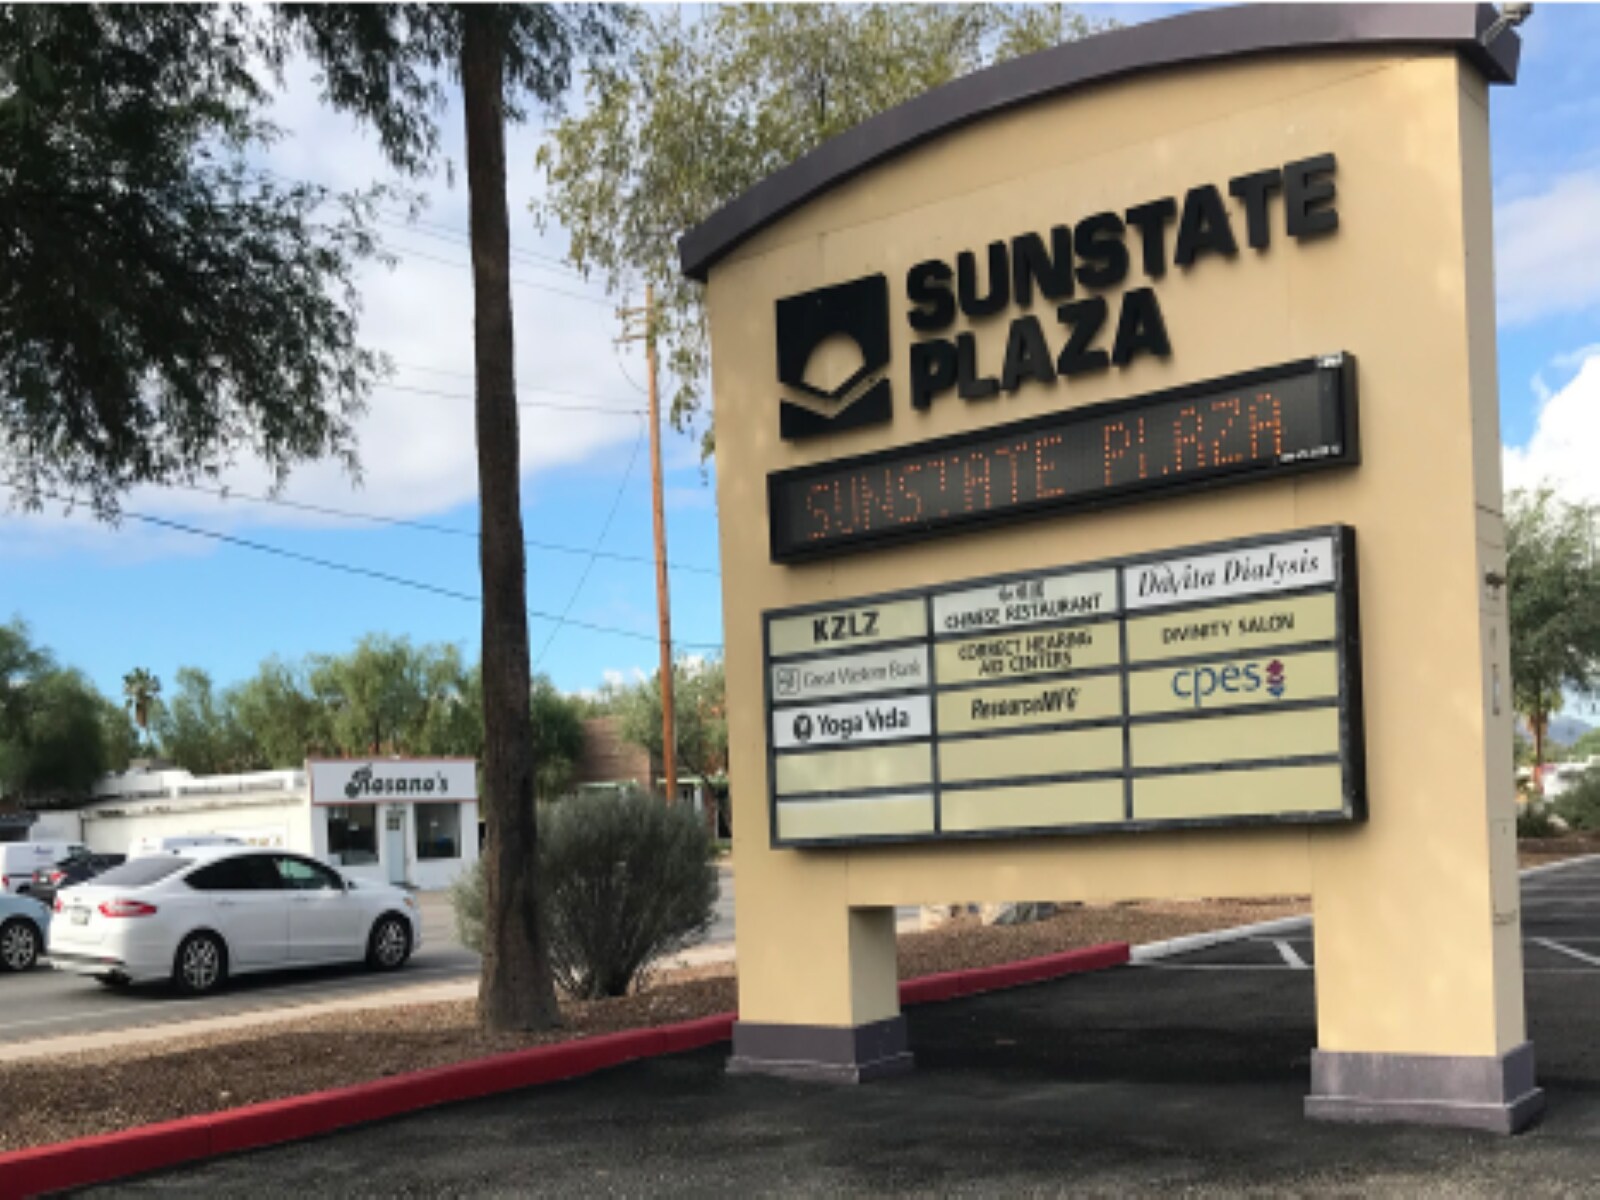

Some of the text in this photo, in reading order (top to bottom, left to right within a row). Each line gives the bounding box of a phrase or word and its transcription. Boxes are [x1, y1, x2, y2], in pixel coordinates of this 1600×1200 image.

[907, 153, 1339, 332] SUNSTATE
[910, 287, 1172, 411] PLAZA
[807, 392, 1283, 540] SUNSTATE PLAZA
[1138, 548, 1319, 598] DaVita Dialysis
[813, 611, 880, 643] KZLZ
[944, 593, 1102, 629] CHINESE RESTAURANT
[1162, 612, 1296, 645] DIVINITY SALON
[958, 630, 1093, 661] CORRECT HEARING
[979, 651, 1072, 675] AID CENTERS
[1172, 662, 1262, 708] cpes
[817, 706, 911, 740] Yoga Vida
